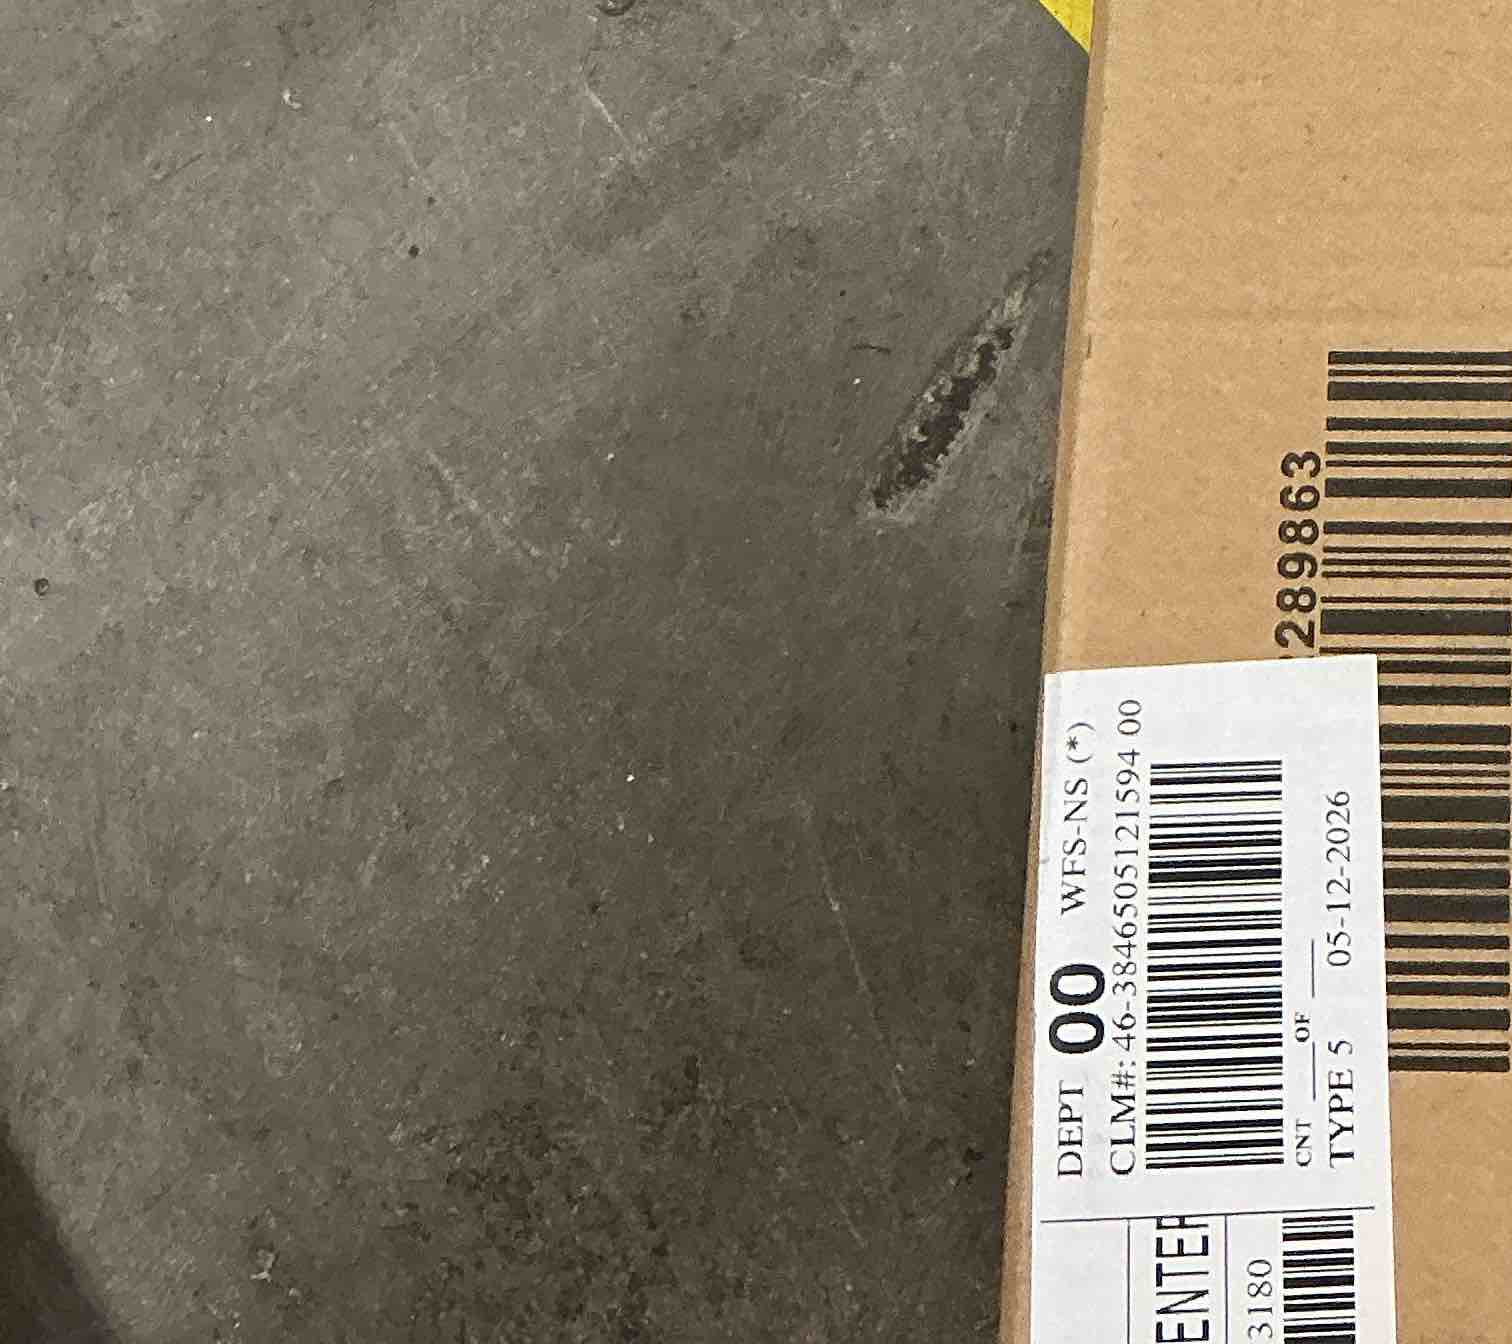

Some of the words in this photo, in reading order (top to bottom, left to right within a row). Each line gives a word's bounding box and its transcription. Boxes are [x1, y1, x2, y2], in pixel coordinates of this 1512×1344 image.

[1274, 452, 1321, 658] 289863
[1116, 699, 1142, 736] 00
[1060, 778, 1088, 916] WFS-NS
[1326, 791, 1351, 967] 05-12-2026
[1111, 749, 1141, 1052] 46-3846505121594
[1048, 964, 1105, 1054] 00
[1294, 1010, 1310, 1042] OF
[1327, 1040, 1353, 1054] 5
[1058, 1080, 1084, 1177] DEPT
[1110, 1060, 1136, 1176] CLM#:
[1295, 1118, 1311, 1167] CNT
[1328, 1069, 1354, 1168] TYPE
[1247, 1259, 1273, 1339] 3180
